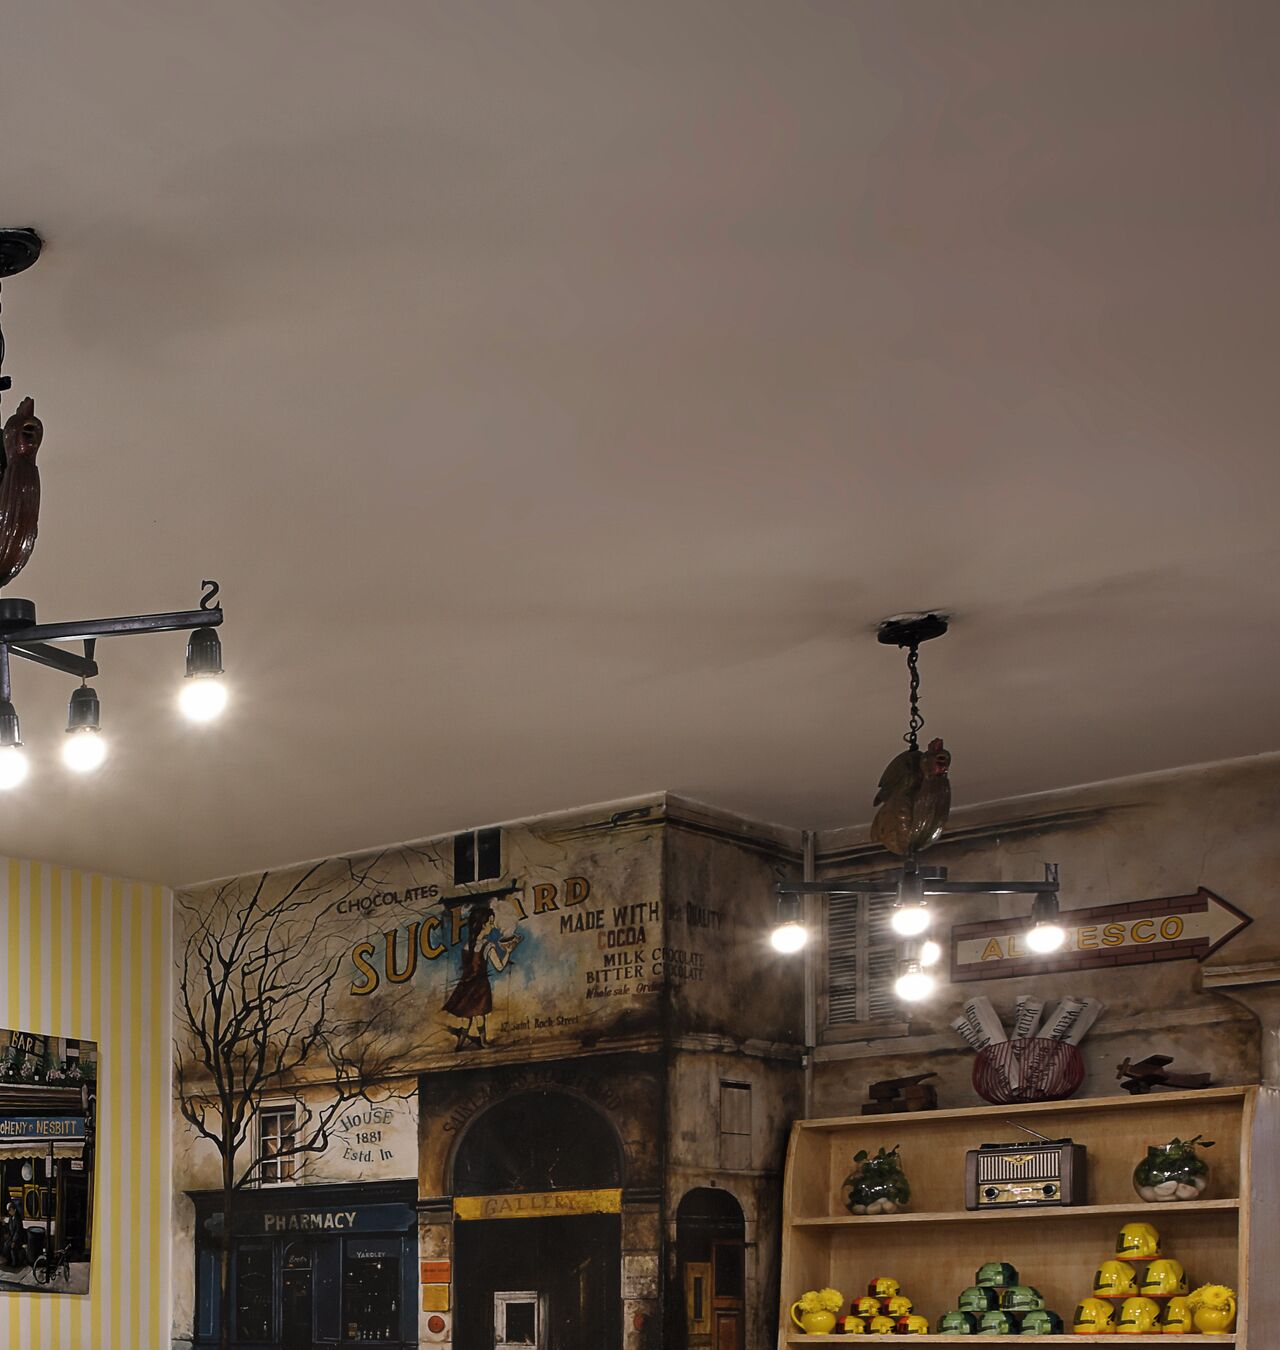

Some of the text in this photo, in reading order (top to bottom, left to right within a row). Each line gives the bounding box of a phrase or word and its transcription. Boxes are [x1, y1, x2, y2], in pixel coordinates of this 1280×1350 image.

[336, 884, 439, 914] CHOCOLATES
[559, 909, 605, 935] MADE
[613, 901, 660, 928] WITH
[597, 926, 647, 950] COCOA
[981, 915, 1184, 961] ALESCO
[603, 950, 645, 968] MILK
[586, 965, 644, 985] BITTER
[11, 1032, 34, 1053] BAR
[36, 1119, 77, 1135] NESBITT
[340, 1110, 394, 1131] HOUSE
[356, 1131, 382, 1145] 1881
[343, 1147, 394, 1163] Estd. In
[485, 1194, 578, 1216] GALLERY
[264, 1211, 358, 1232] PHARMACY
